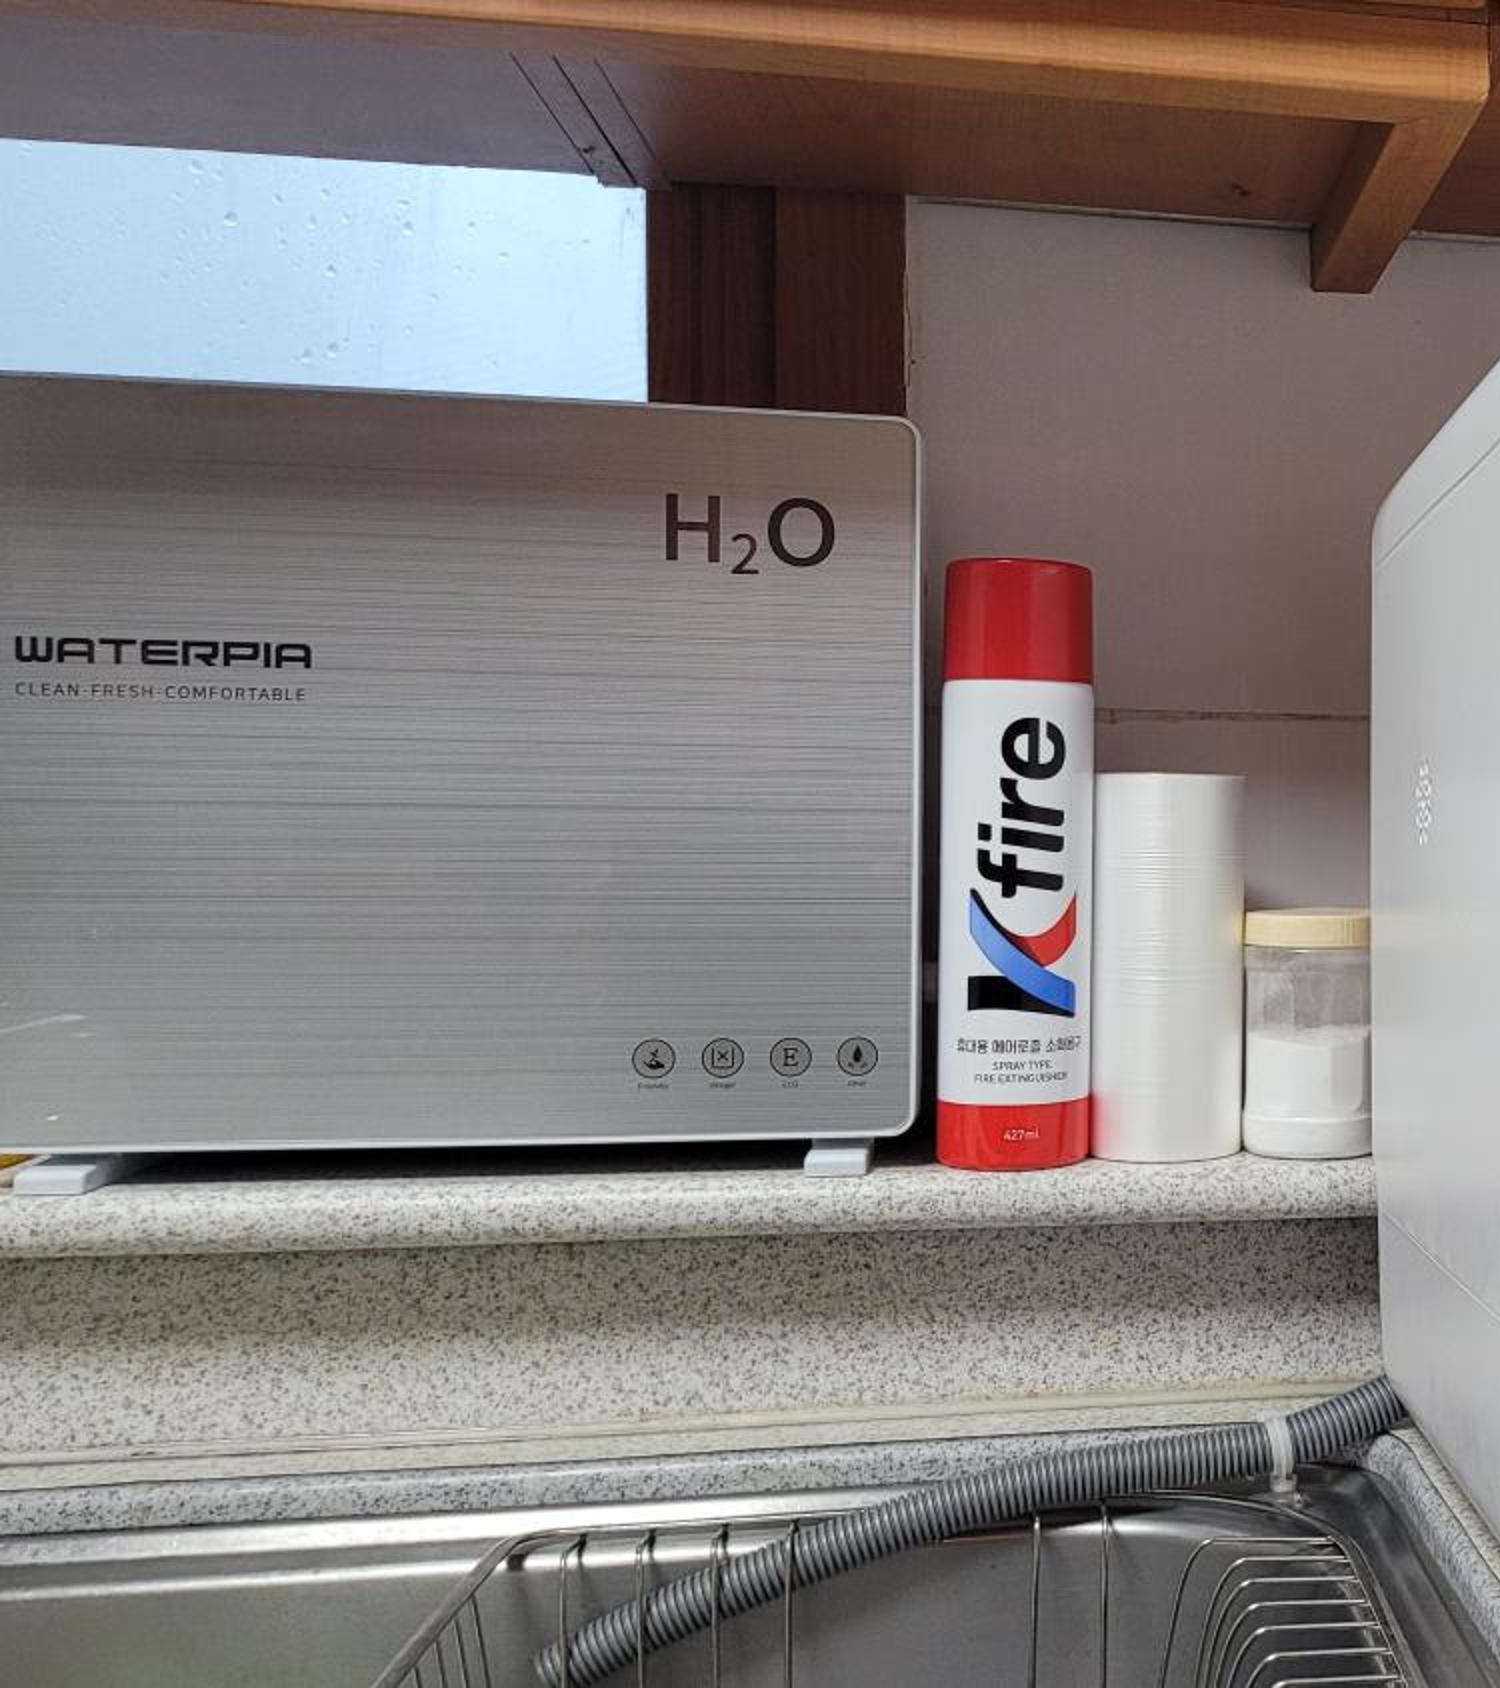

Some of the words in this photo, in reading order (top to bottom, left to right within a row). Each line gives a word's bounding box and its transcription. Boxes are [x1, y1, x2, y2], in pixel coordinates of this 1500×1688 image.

[15, 635, 312, 669] WATERPIA
[956, 1038, 989, 1055] 휴대용
[992, 1061, 1025, 1070] SPRAY
[1028, 1060, 1052, 1070] TYPE
[975, 1074, 997, 1083] FIRE
[998, 1072, 1068, 1083] EXTINGUISHER
[1003, 1126, 1040, 1141] 427ml
